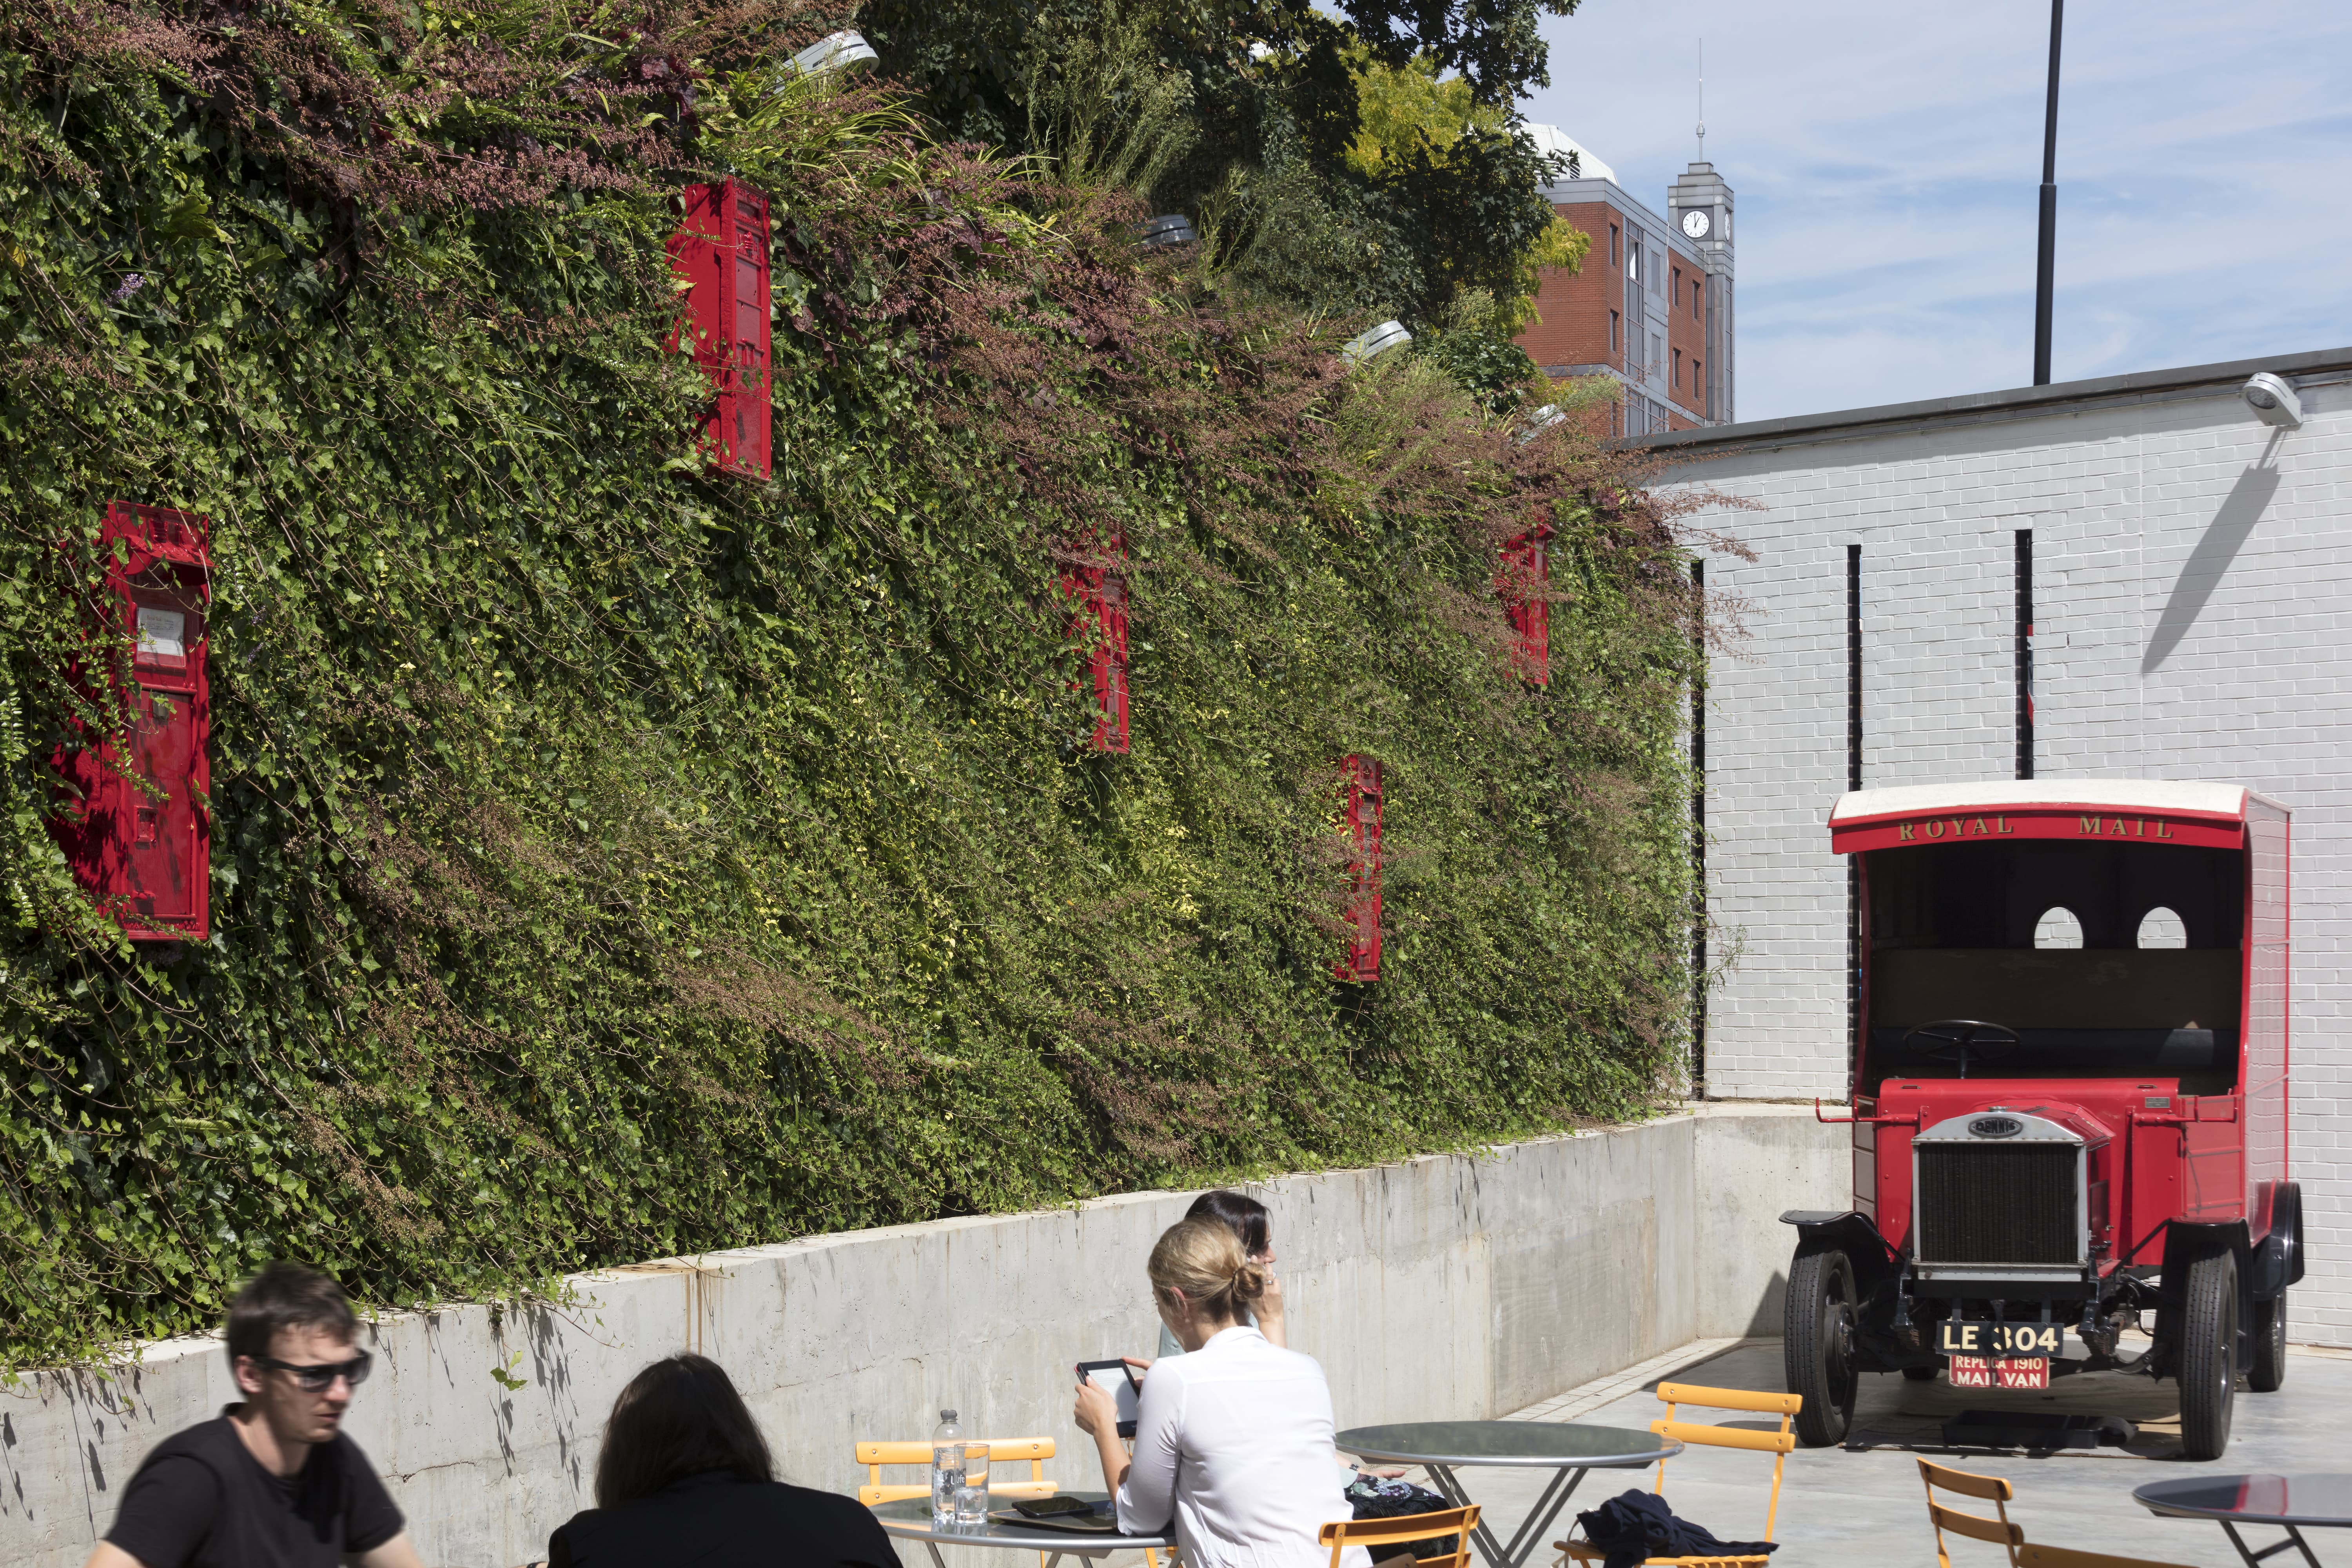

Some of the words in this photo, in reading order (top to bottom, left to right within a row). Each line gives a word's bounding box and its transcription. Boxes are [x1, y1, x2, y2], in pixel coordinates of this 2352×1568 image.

[1899, 815, 2013, 841] ROYAL
[2078, 816, 2172, 838] MAIL
[1976, 1120, 2015, 1133] DENNIS
[1944, 1326, 1979, 1349] LE
[1993, 1327, 2058, 1351] 304
[1956, 1356, 2006, 1369] REPLICA
[2014, 1357, 2043, 1370] 1910
[1957, 1372, 2001, 1386] MAIL
[2004, 1373, 2041, 1387] VAN
